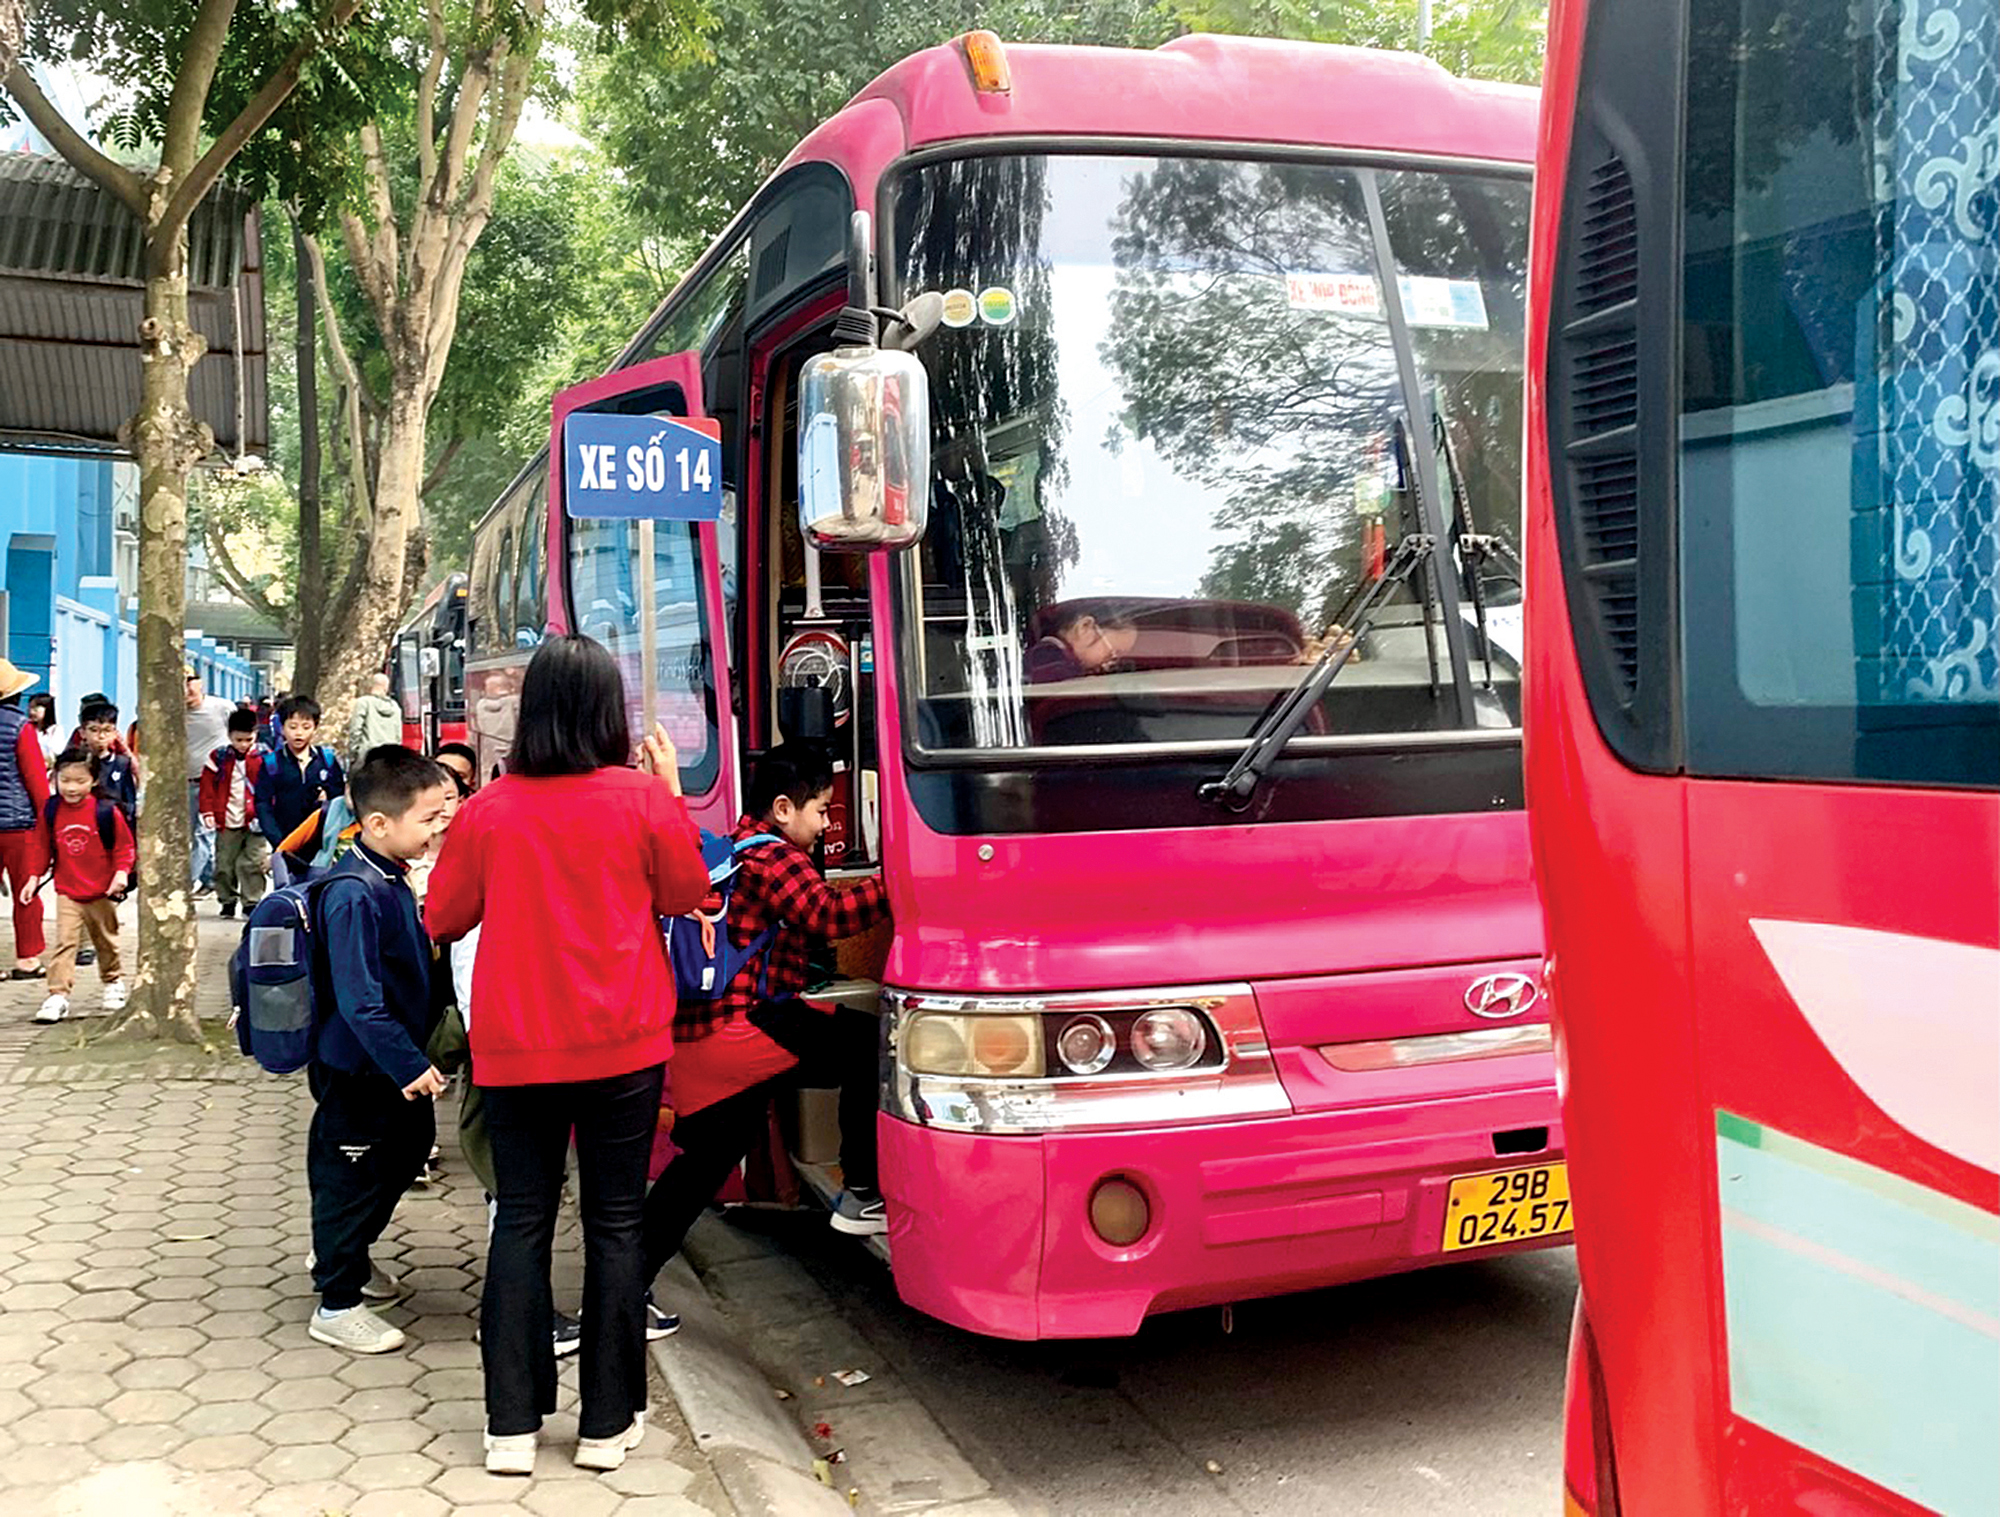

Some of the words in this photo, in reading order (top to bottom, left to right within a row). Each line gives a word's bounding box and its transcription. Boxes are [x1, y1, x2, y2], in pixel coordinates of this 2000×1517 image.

[578, 444, 617, 490] XE
[626, 431, 667, 492] SỐ
[675, 447, 712, 492] 14
[1488, 1170, 1549, 1206] 29B
[1459, 1200, 1569, 1245] 024.57
